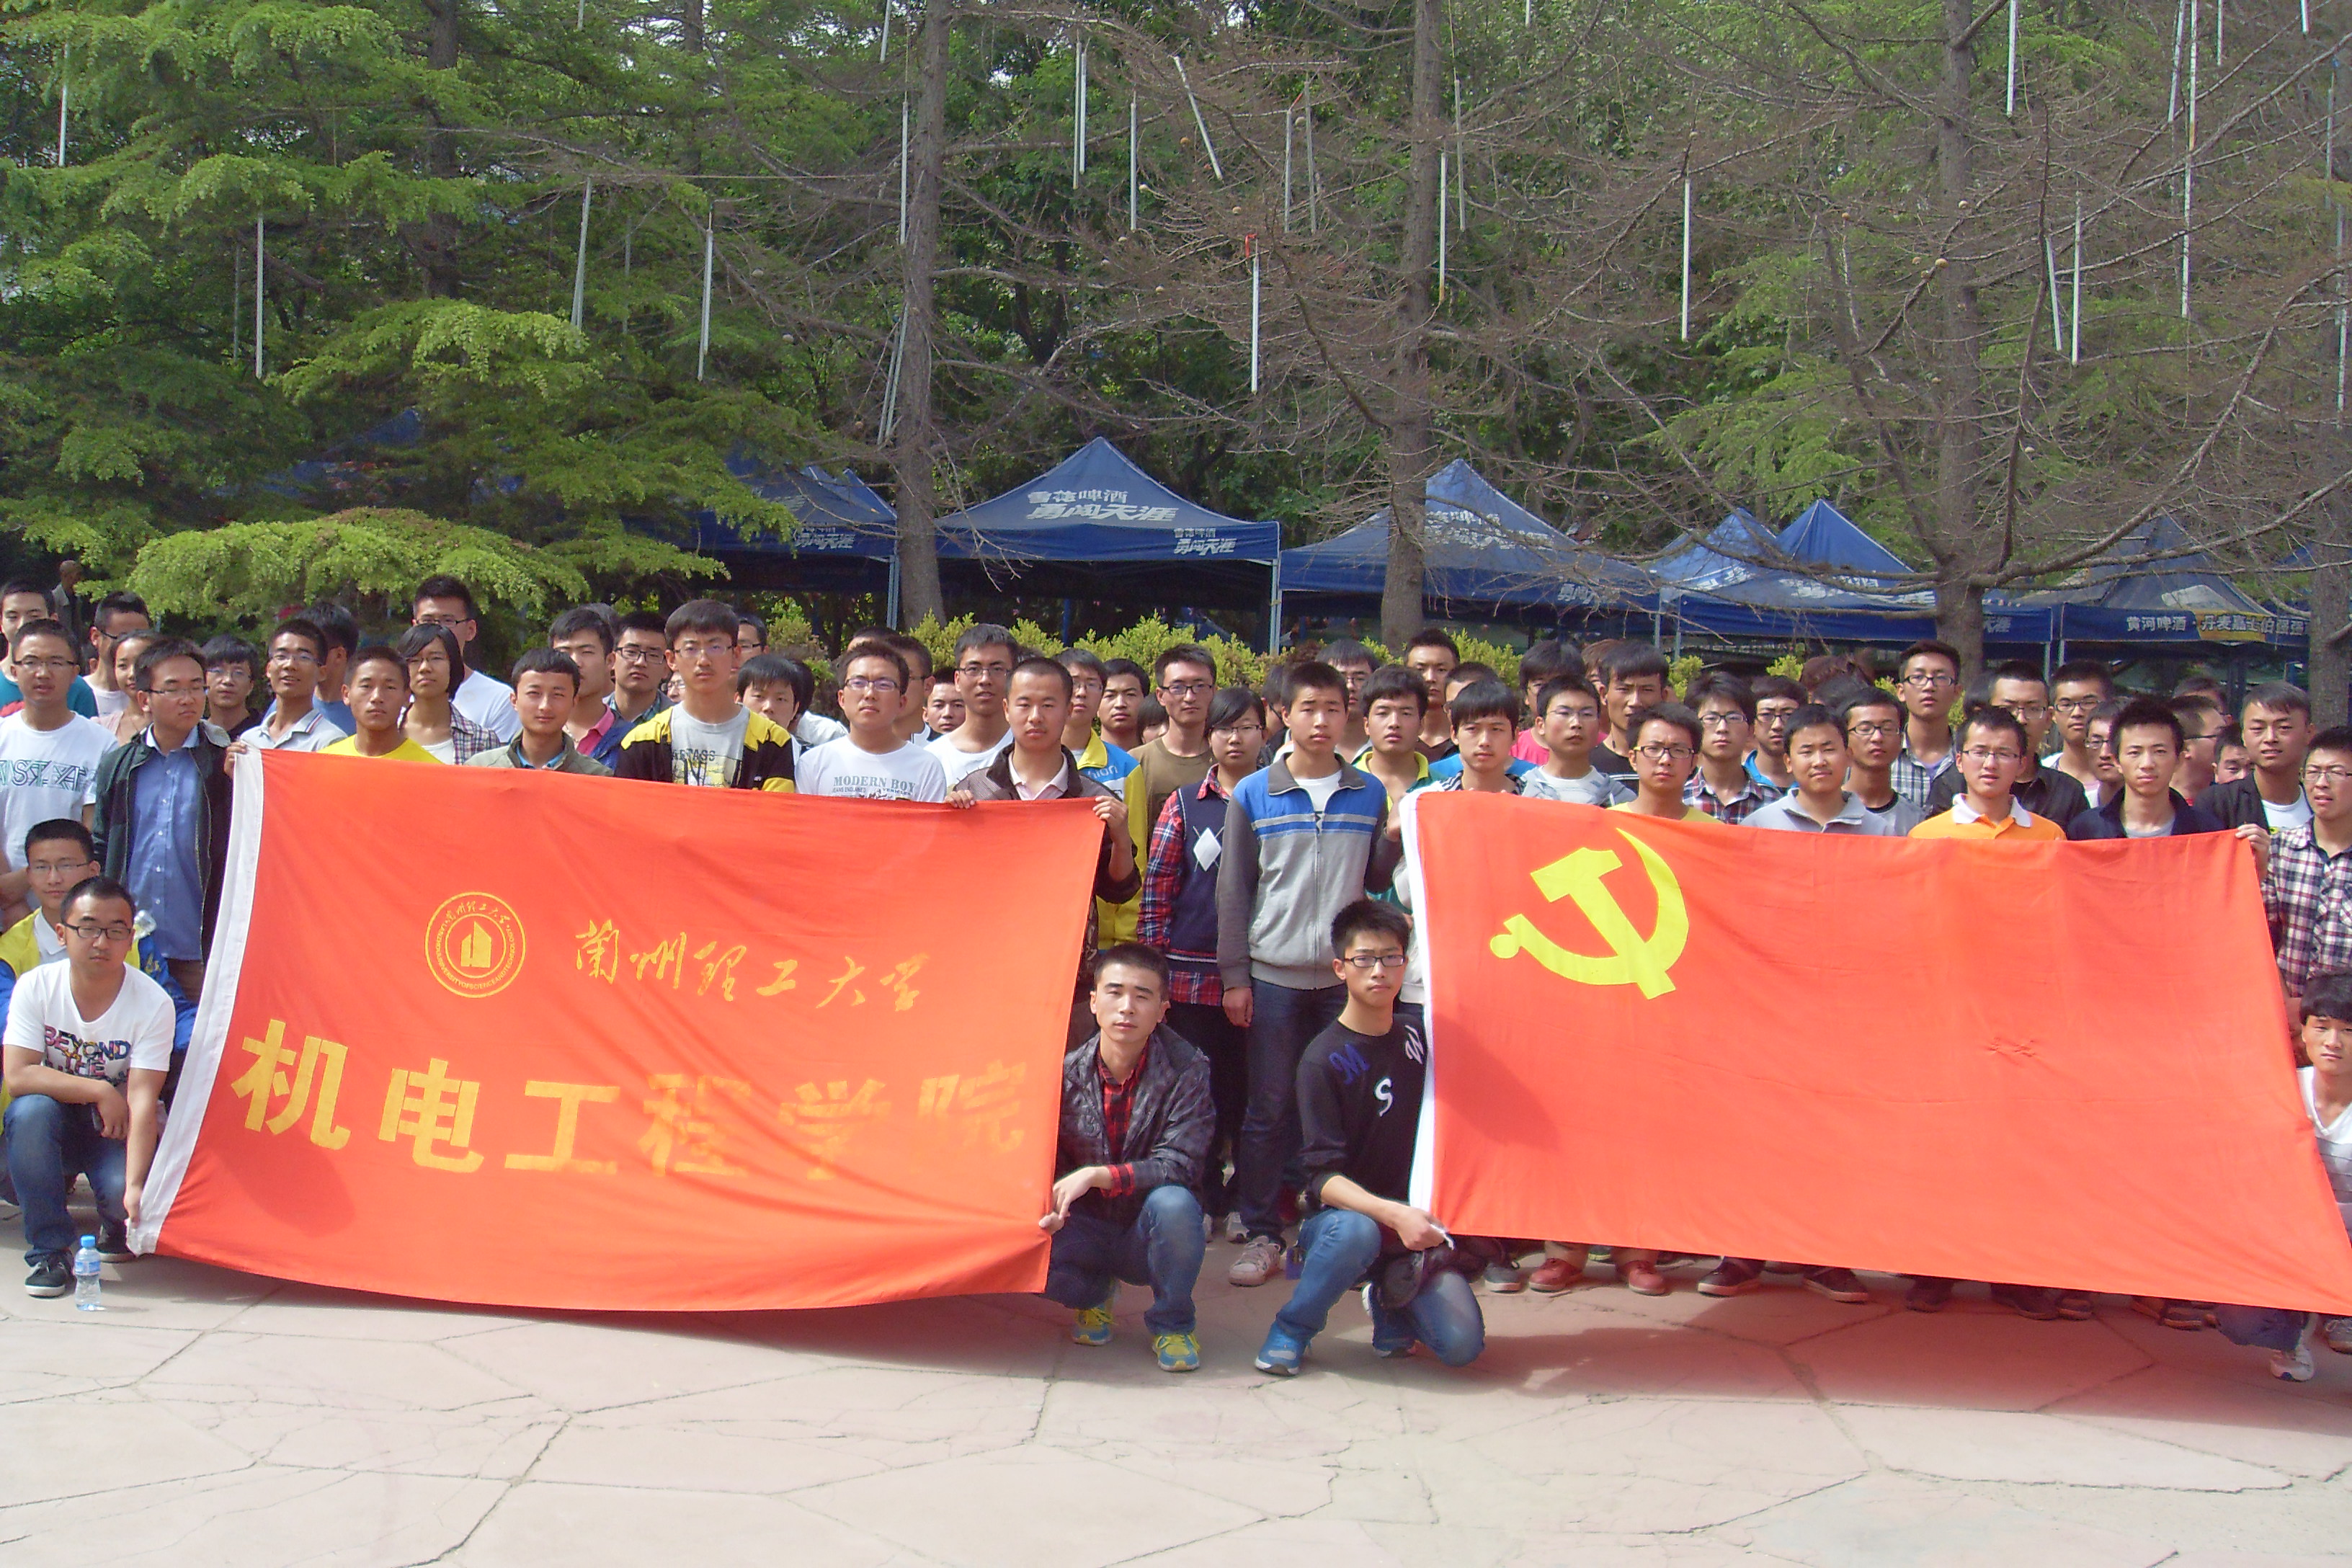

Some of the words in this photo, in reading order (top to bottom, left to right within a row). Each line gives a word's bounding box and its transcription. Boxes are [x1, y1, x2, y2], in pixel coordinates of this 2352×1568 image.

[1026, 504, 1179, 521] 勇闯天涯
[834, 776, 887, 787] MODERN
[891, 779, 916, 793] BOY
[45, 1025, 131, 1061] BEYOND
[231, 1018, 1026, 1180] 机电工程学院
[1375, 1077, 1394, 1117] S
